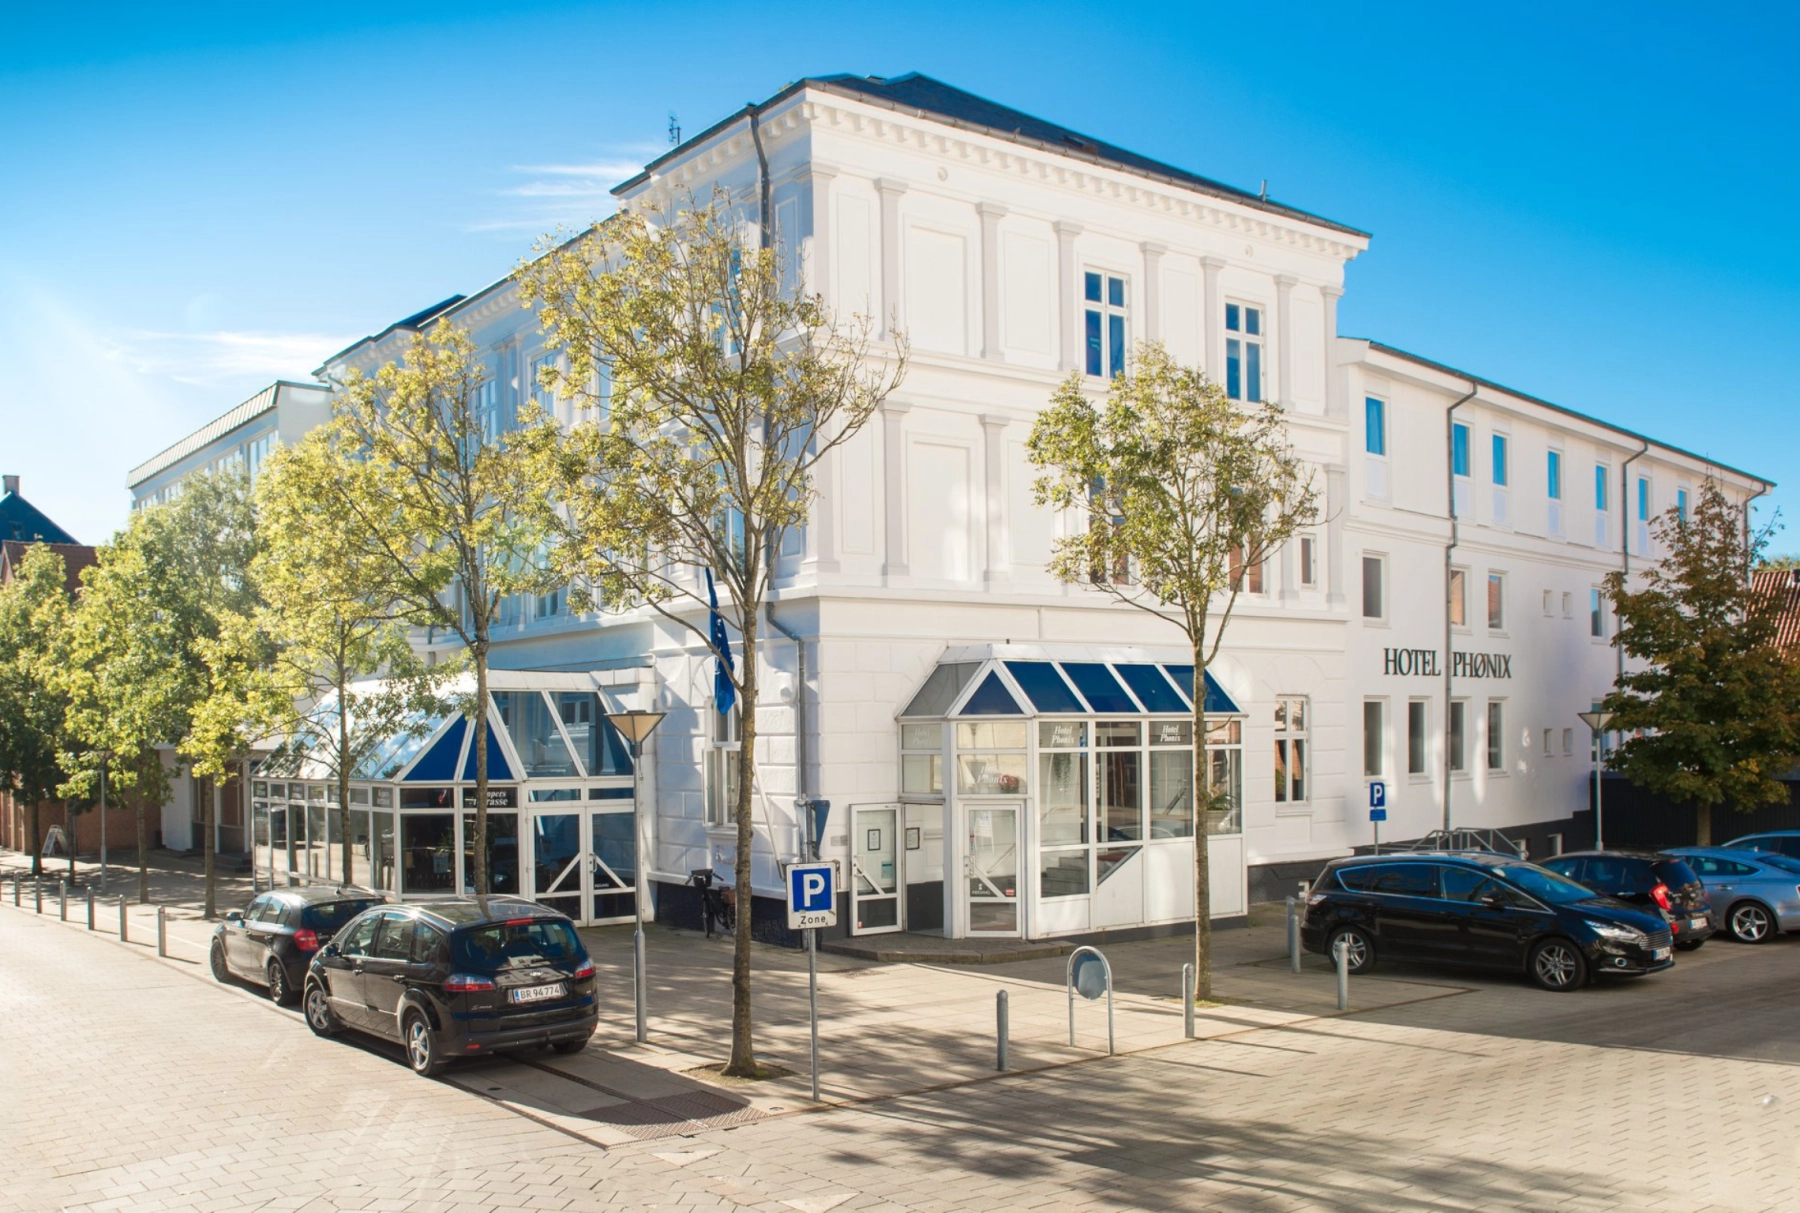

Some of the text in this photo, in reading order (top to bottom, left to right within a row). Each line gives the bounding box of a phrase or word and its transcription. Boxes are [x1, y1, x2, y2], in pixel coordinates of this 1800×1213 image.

[1383, 648, 1512, 679] HOTEL PHØNIX
[1054, 725, 1073, 735] Hotel
[1162, 724, 1180, 734] Hotel
[803, 873, 826, 908] P
[800, 915, 826, 925] Zone
[520, 989, 532, 1000] BR
